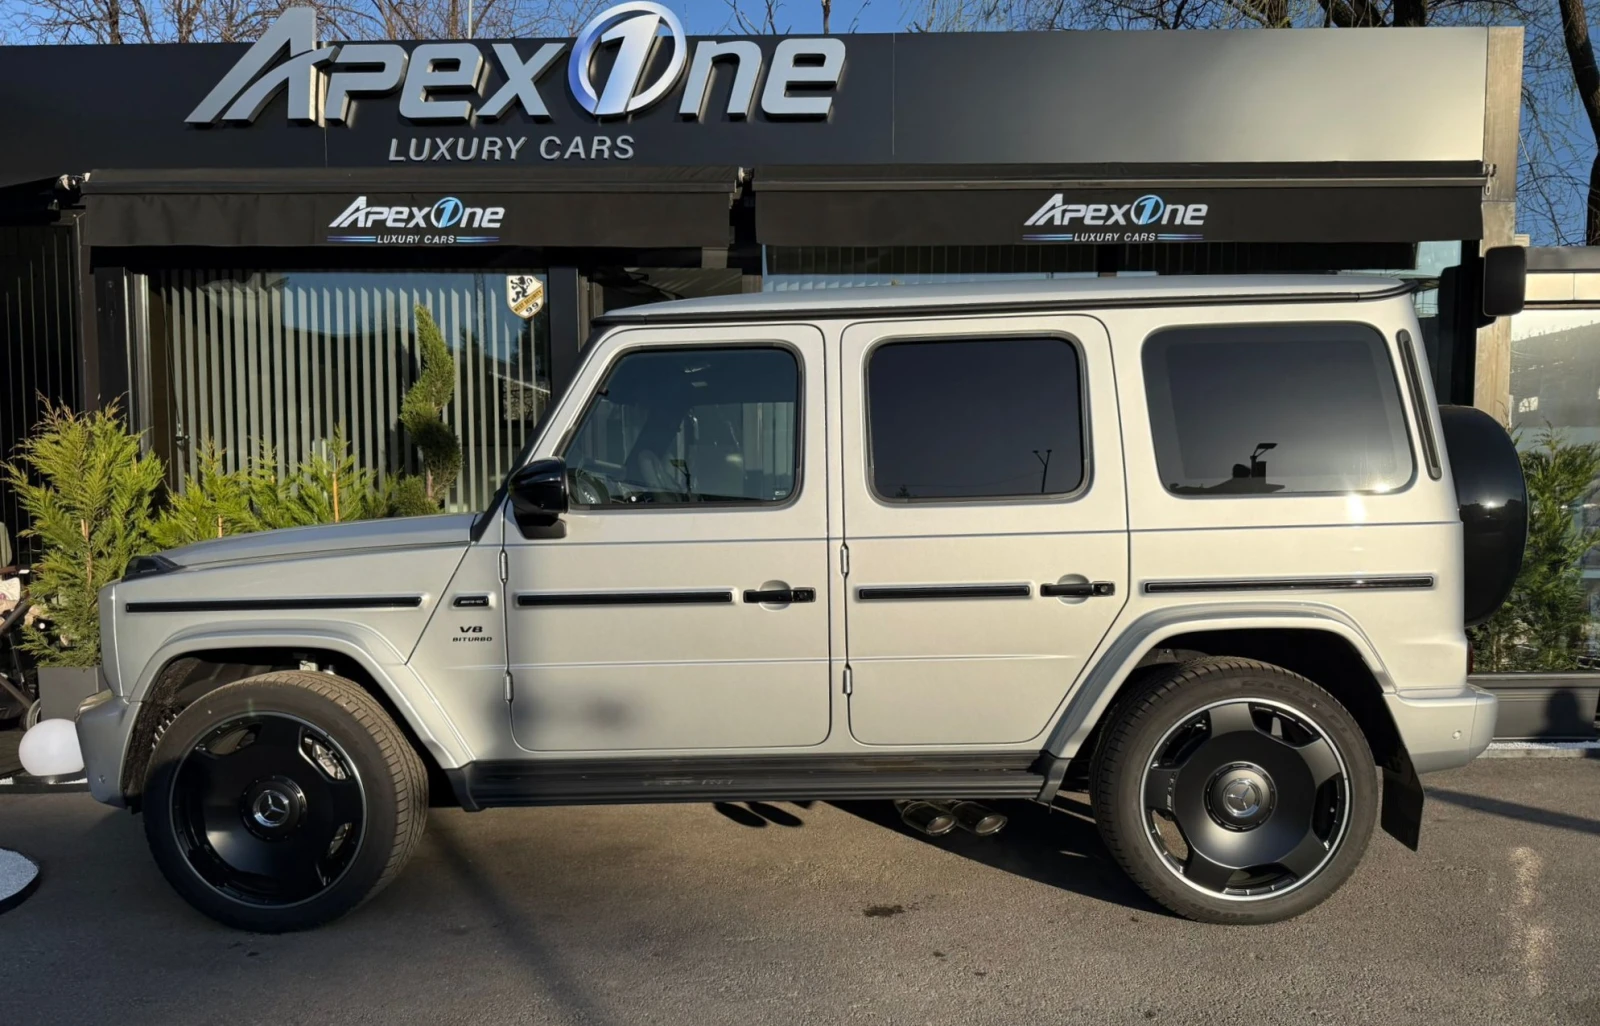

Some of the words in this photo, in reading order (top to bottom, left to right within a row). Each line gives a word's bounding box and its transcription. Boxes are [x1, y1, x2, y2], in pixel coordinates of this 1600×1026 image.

[388, 136, 527, 162] LUXURY
[539, 135, 635, 161] CARS
[377, 235, 420, 244] LUXURY
[424, 235, 455, 244] CARS
[1074, 232, 1120, 242] LUXURY
[1124, 232, 1156, 242] CARS
[526, 302, 539, 314] 99
[459, 625, 483, 633] V8
